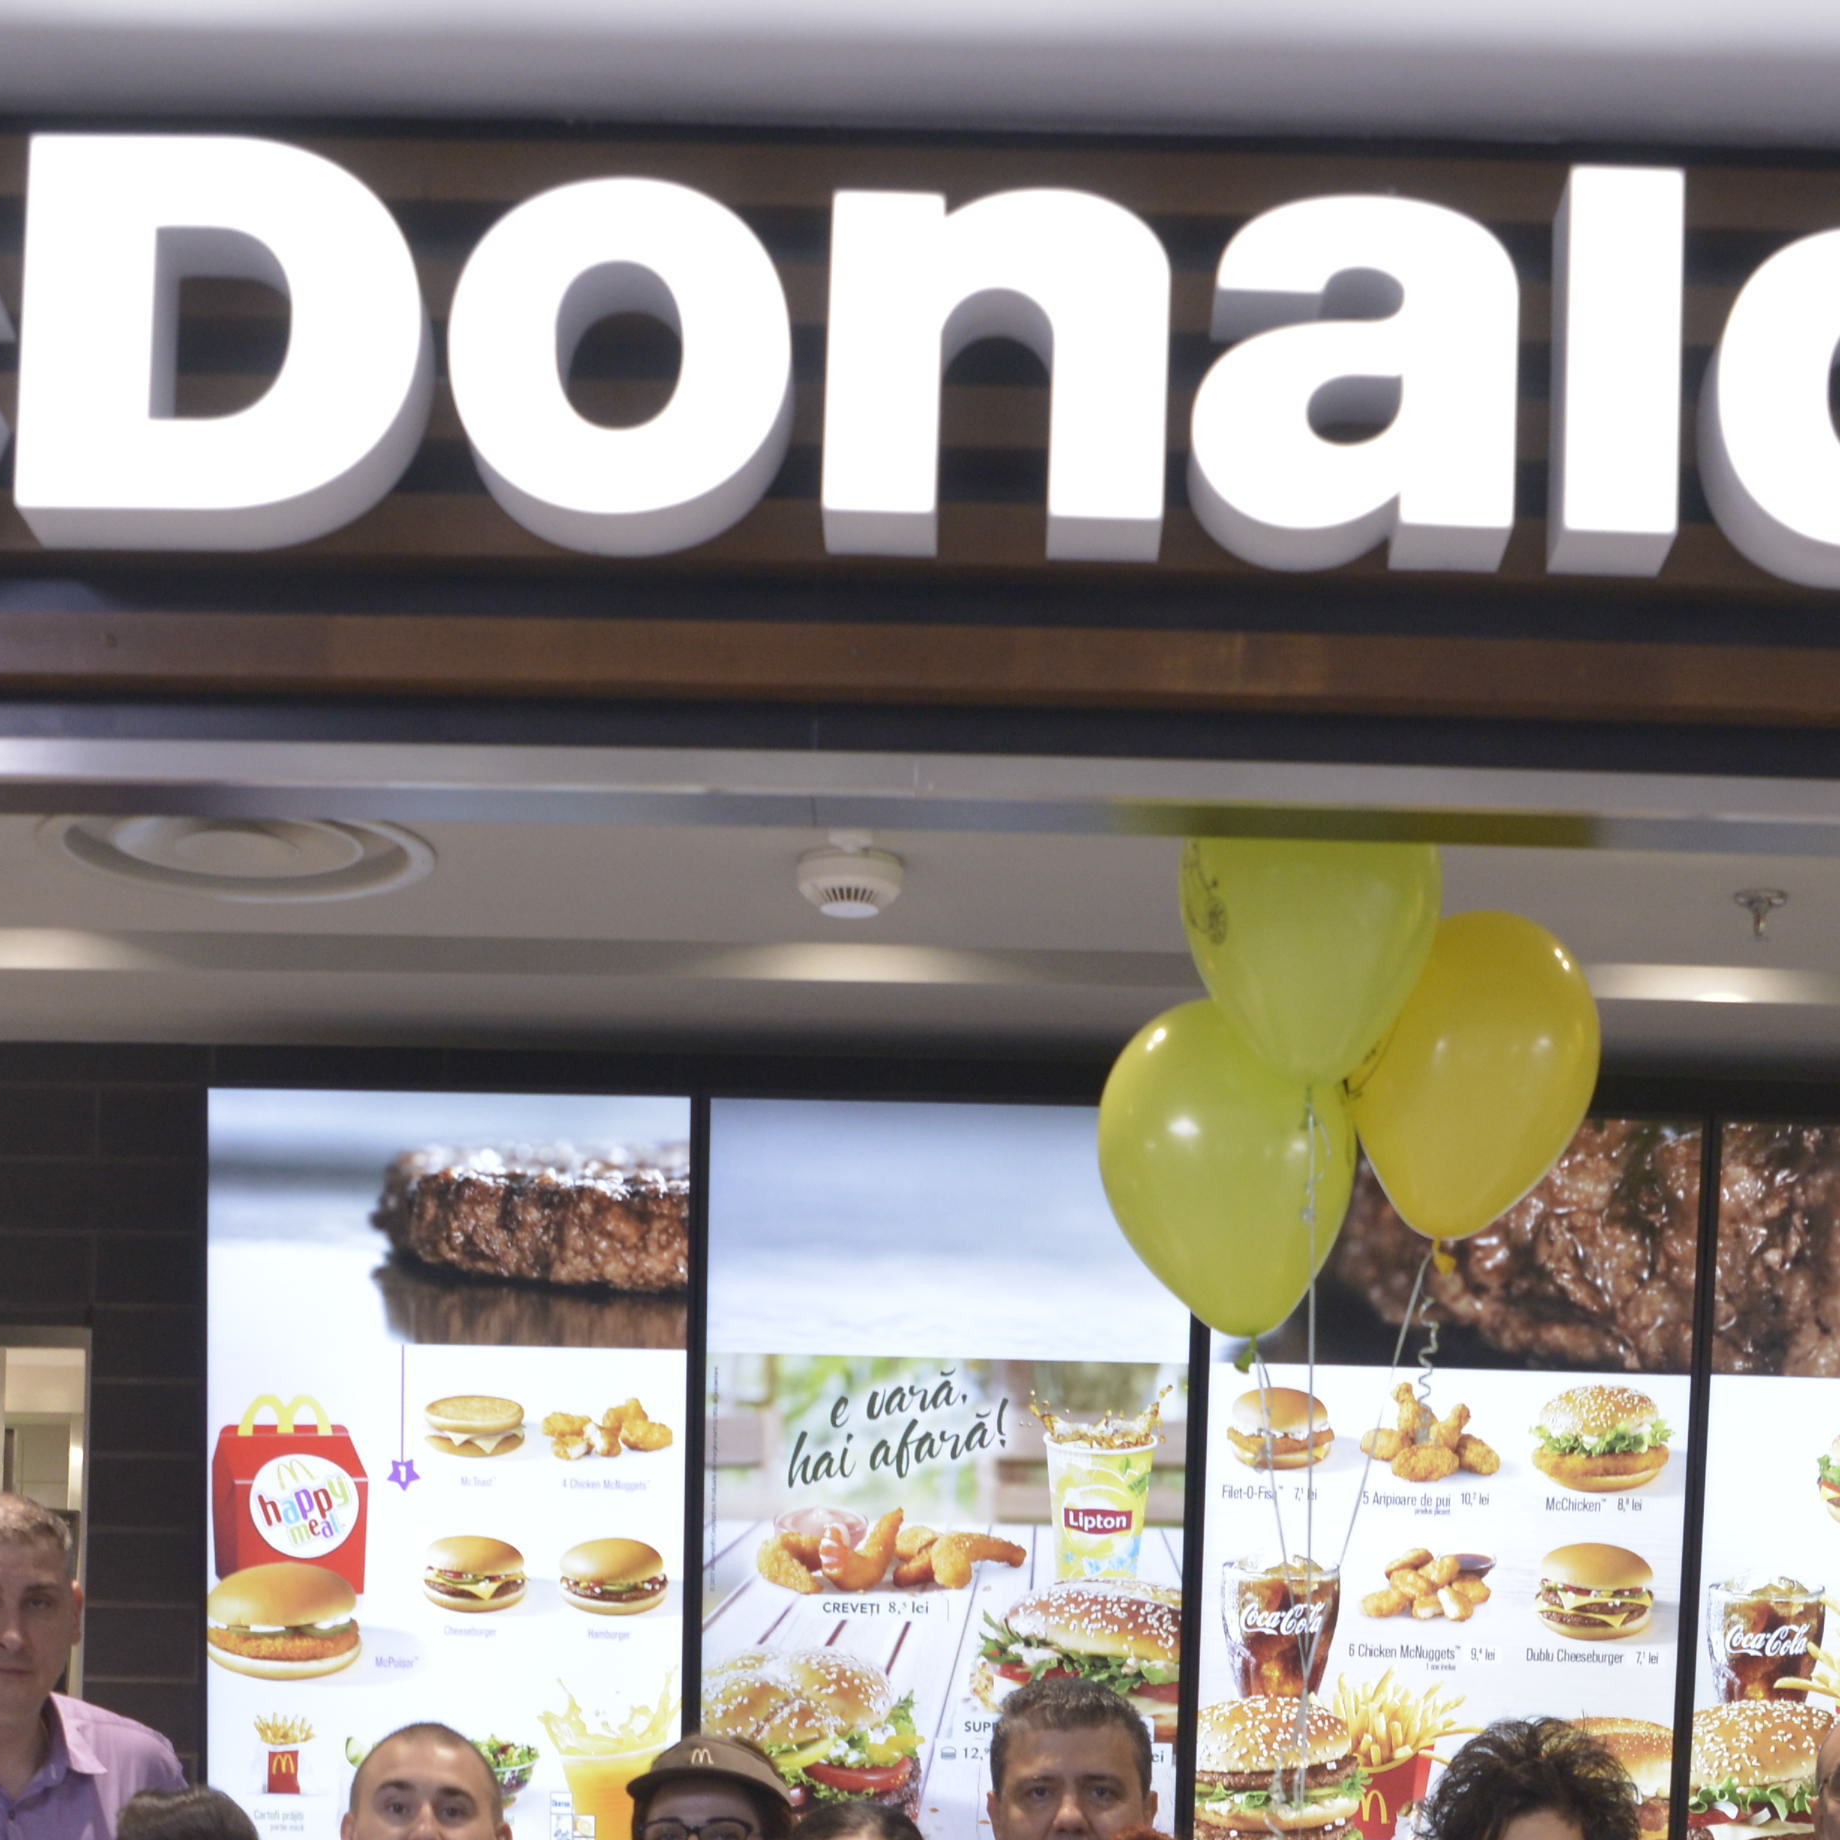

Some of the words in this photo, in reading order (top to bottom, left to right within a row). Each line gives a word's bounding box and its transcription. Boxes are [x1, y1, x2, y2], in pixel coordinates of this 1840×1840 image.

[830, 1397, 850, 1428] e
[787, 1431, 857, 1489] hai
[570, 1479, 601, 1490] Chicken
[257, 1475, 351, 1527] happy
[1372, 1491, 1417, 1508] Aripioare
[1420, 1492, 1433, 1506] de
[1435, 1492, 1451, 1508] pui
[1478, 1493, 1490, 1506] lei
[1632, 1499, 1642, 1511] lei
[1068, 1510, 1128, 1534] Lipton
[911, 1600, 930, 1615] lei
[444, 1625, 496, 1638] Cheeseburger
[587, 1628, 631, 1642] Hamburger
[1349, 1643, 1355, 1657] 6
[1358, 1644, 1397, 1658] Chicken
[1485, 1648, 1496, 1661] lei
[1526, 1648, 1555, 1663] Dublu
[1556, 1649, 1624, 1665] Cheeseburger
[1648, 1652, 1659, 1665] lei
[253, 1809, 280, 1822] Cartofi
